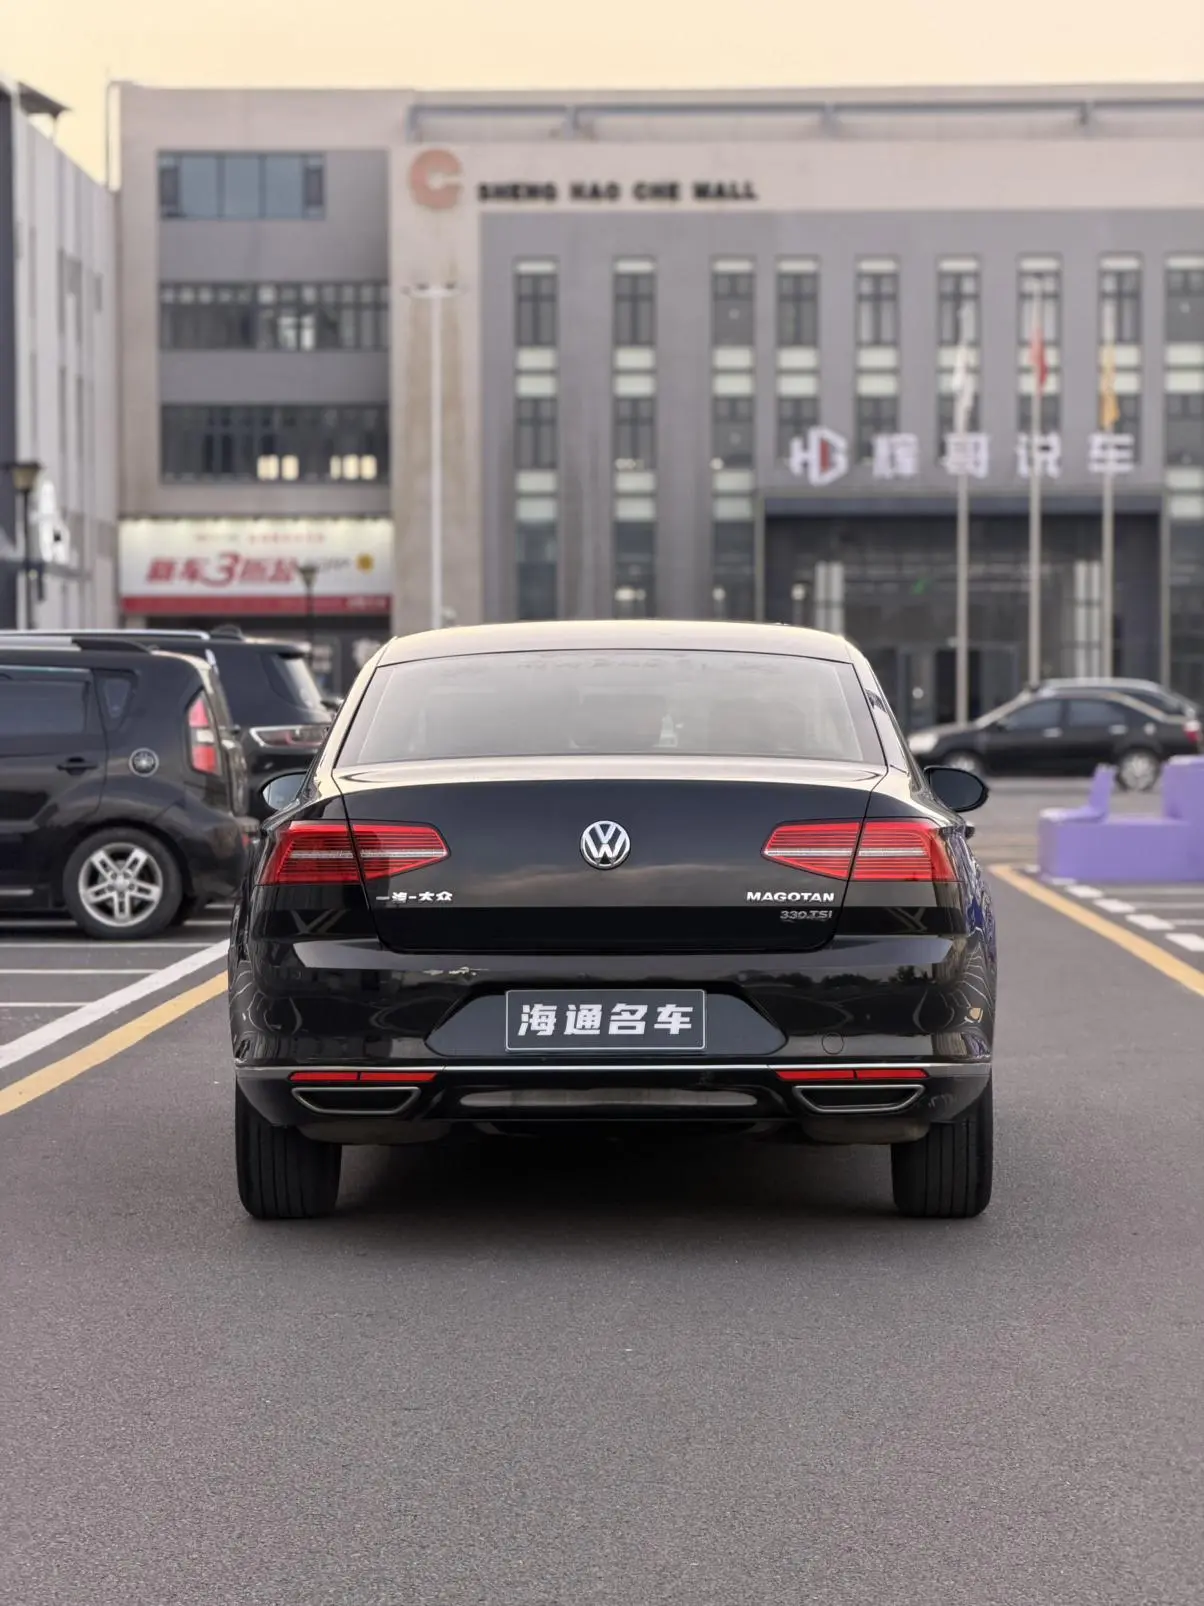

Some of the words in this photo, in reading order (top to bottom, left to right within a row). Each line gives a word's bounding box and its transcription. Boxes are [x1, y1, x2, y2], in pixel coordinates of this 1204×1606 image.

[478, 182, 557, 201] SHENG
[569, 182, 620, 201] HAO
[632, 182, 680, 201] CHE
[692, 181, 758, 201] MALL
[746, 891, 834, 902] MAGOTAN
[517, 1003, 693, 1036] 海通名车
